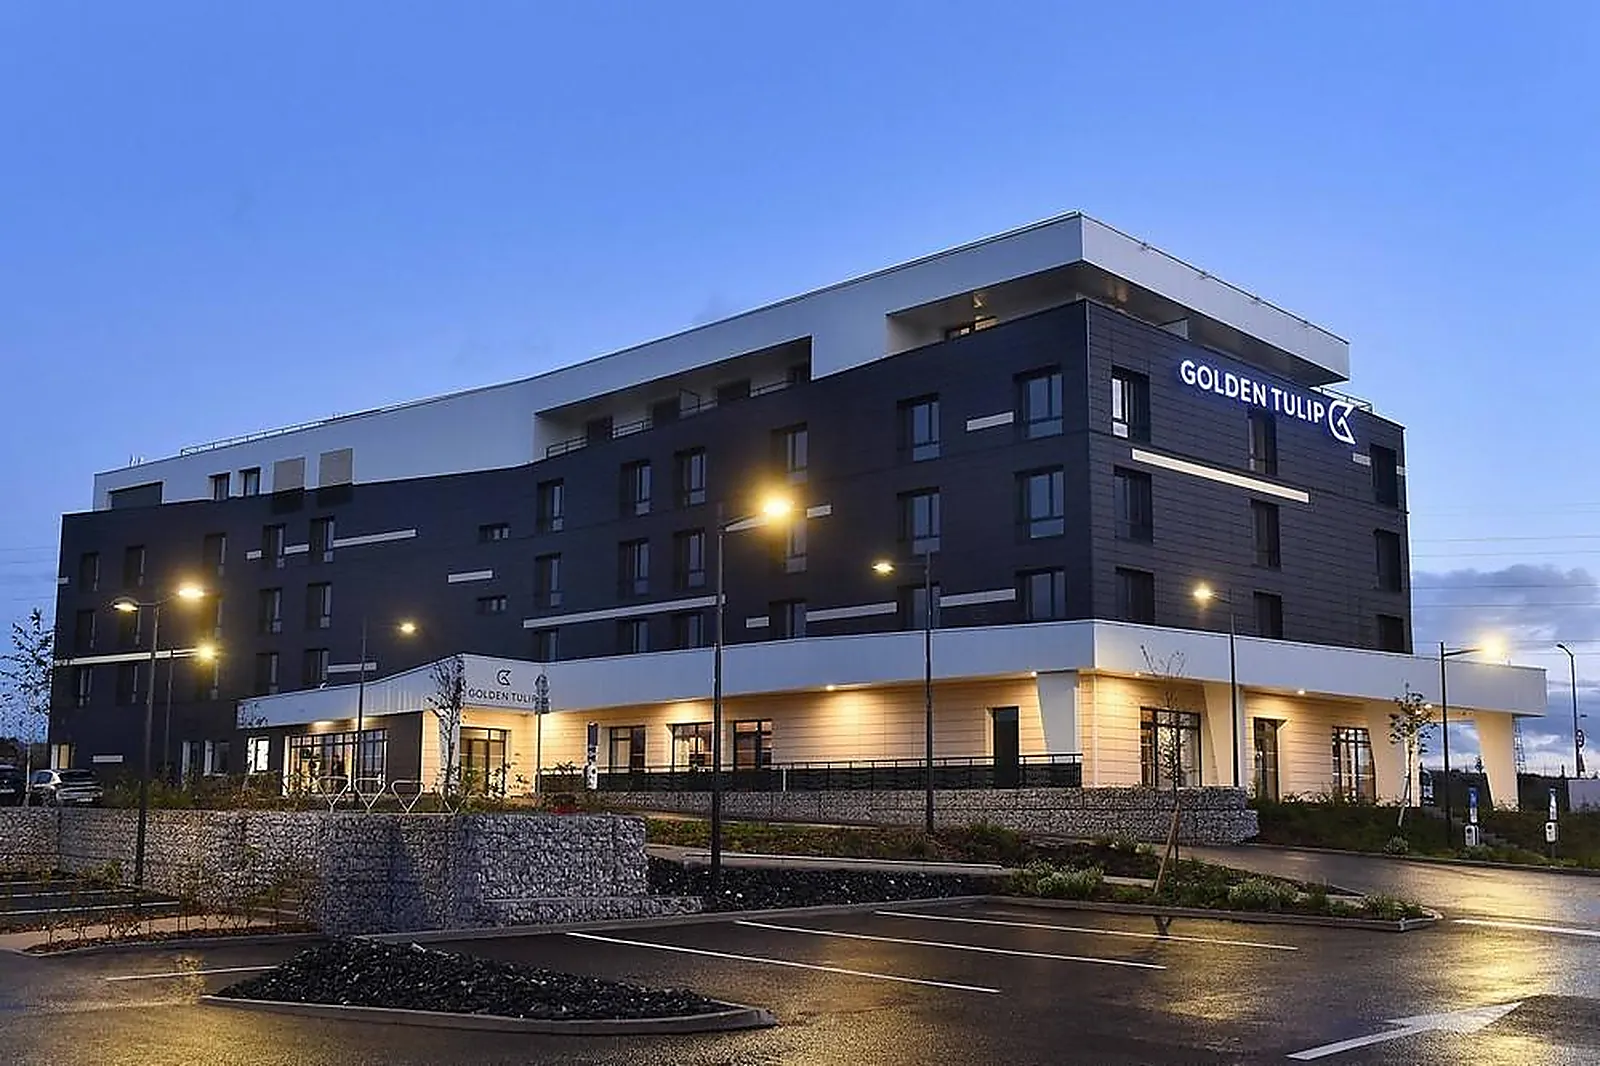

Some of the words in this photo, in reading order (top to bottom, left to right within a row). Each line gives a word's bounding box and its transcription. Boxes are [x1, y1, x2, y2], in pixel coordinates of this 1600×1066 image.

[1180, 360, 1267, 407] GOLDEN
[1271, 388, 1325, 423] TULIP
[468, 688, 509, 701] GOLDEN
